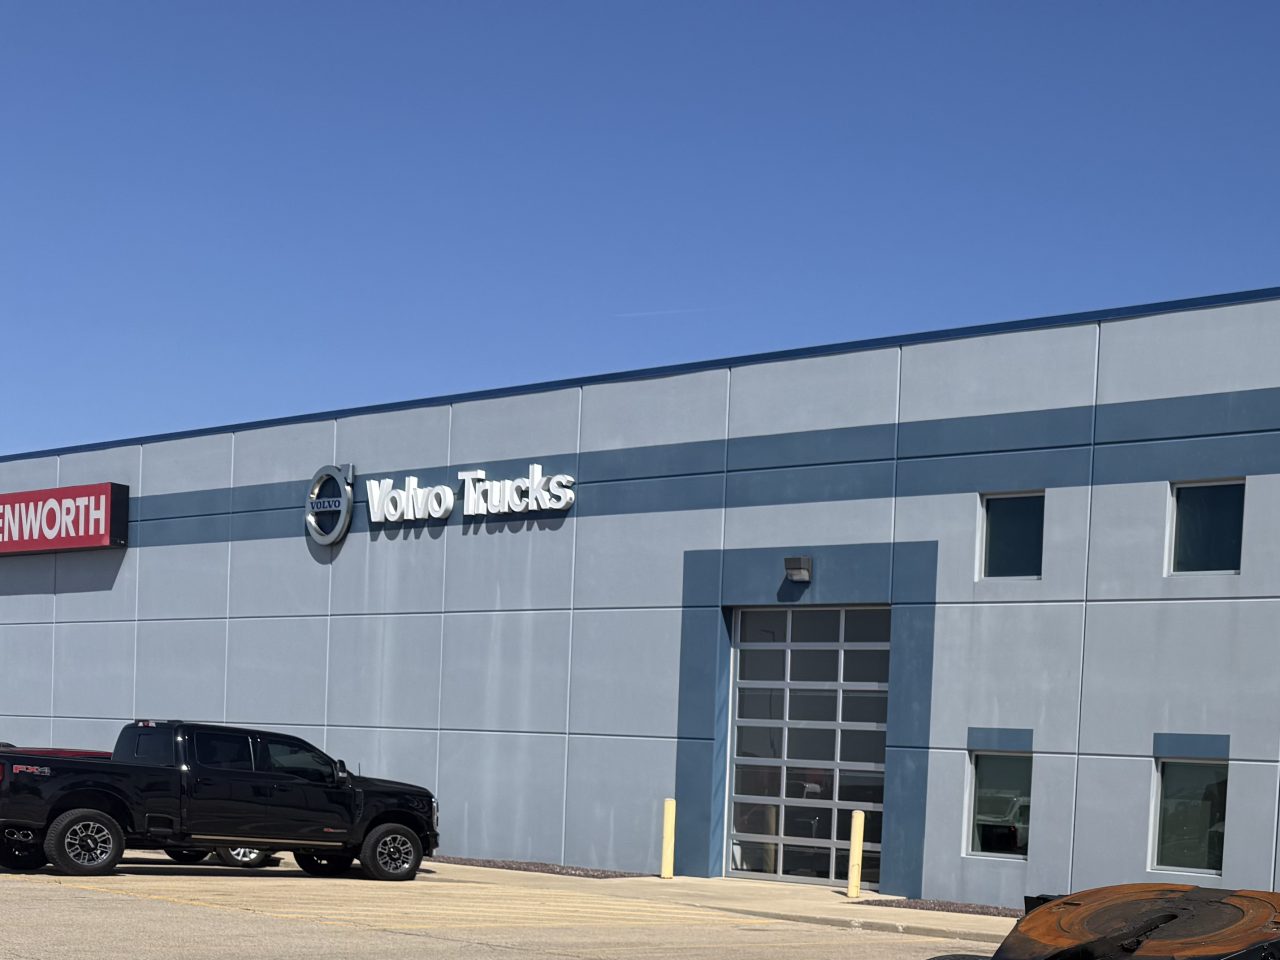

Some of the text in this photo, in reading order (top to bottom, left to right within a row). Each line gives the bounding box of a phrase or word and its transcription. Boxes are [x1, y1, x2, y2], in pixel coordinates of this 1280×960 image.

[310, 500, 341, 510] VOLVO
[366, 463, 574, 523] Volvo Trucks
[0, 494, 106, 542] NWORTH
[13, 764, 51, 776] FX4
